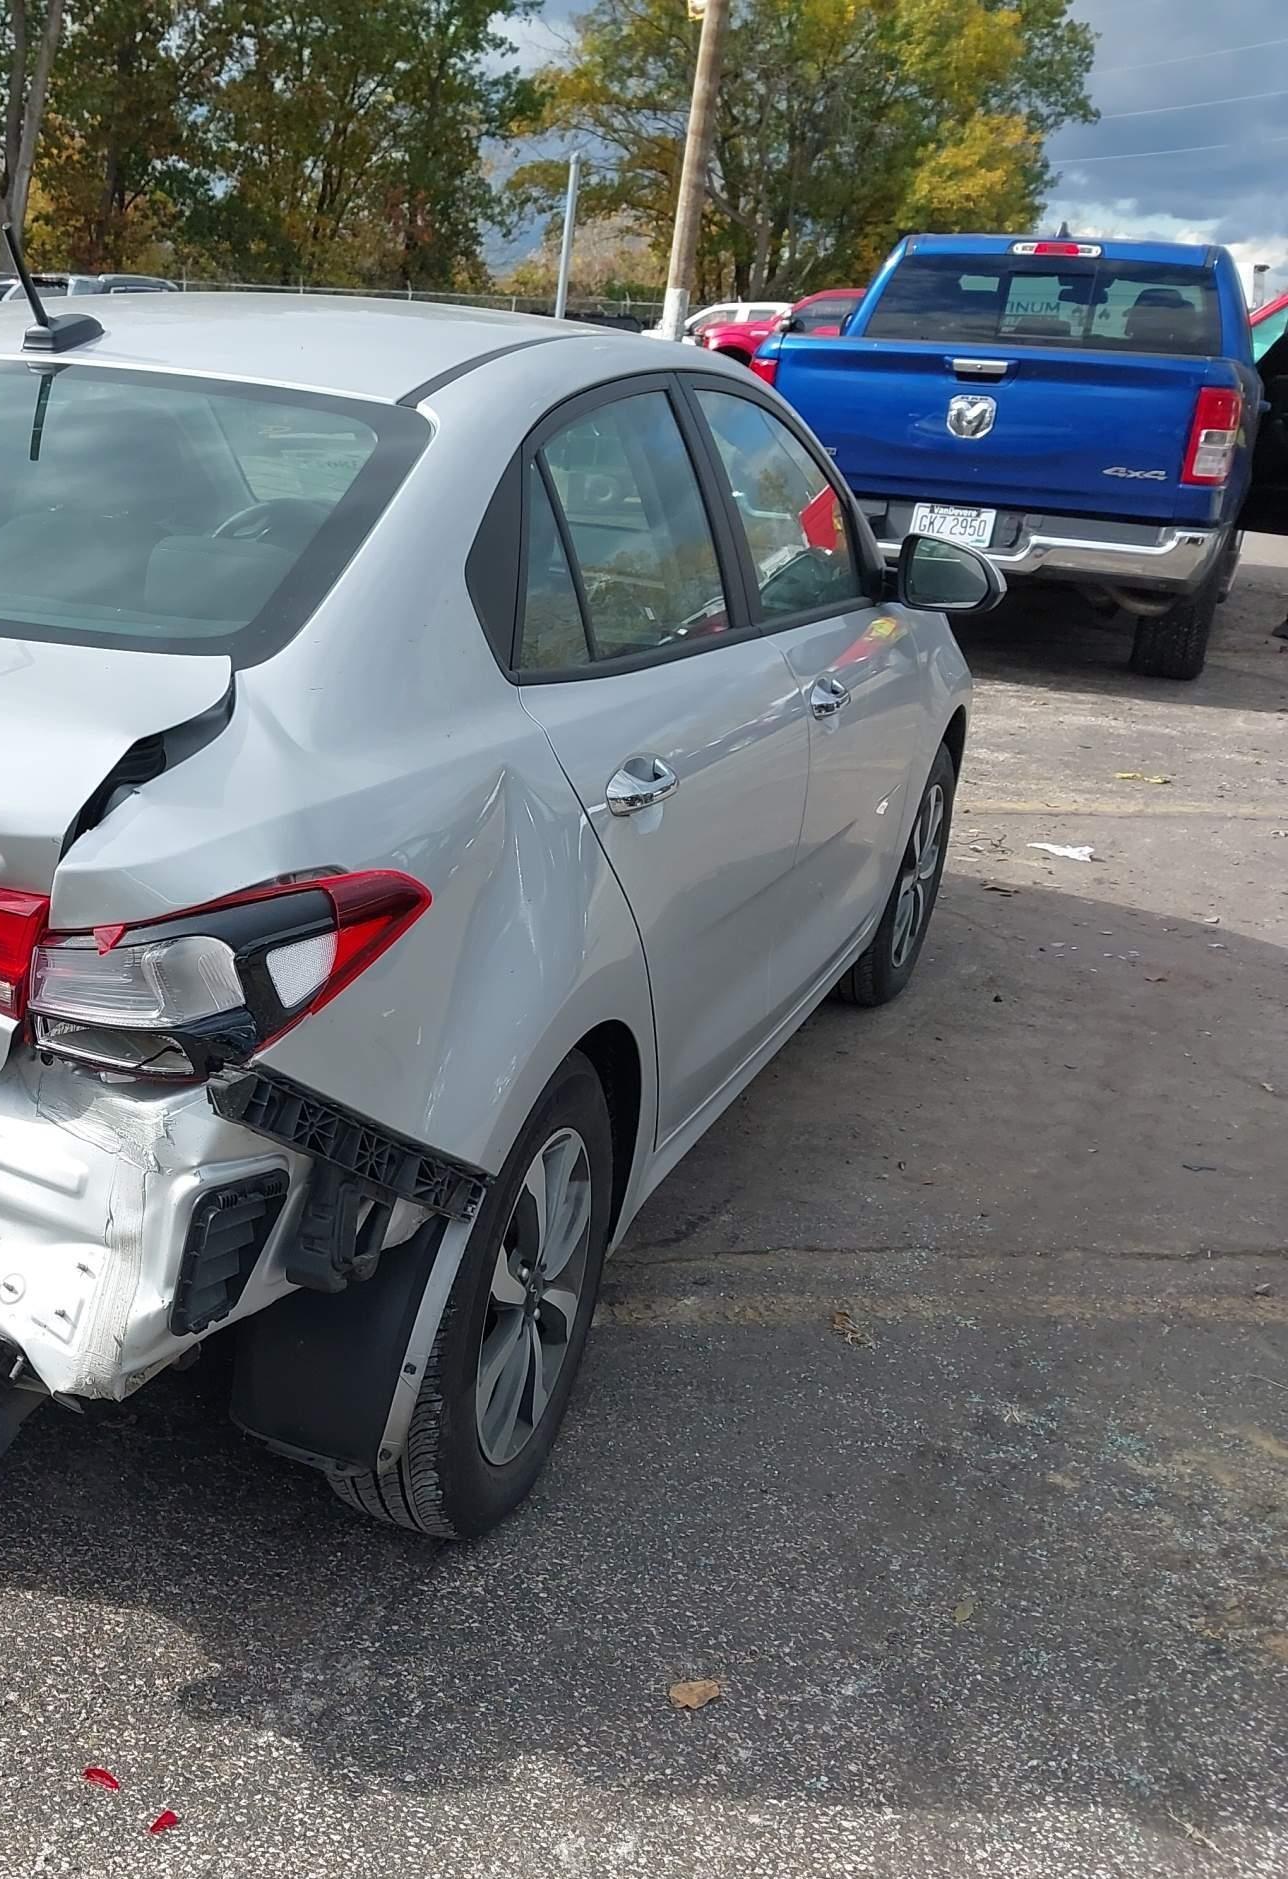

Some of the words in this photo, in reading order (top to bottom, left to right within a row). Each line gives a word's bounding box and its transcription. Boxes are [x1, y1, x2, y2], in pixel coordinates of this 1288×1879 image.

[1008, 300, 1061, 315] INUM
[918, 514, 947, 534] GKZ
[949, 517, 987, 537] 2950
